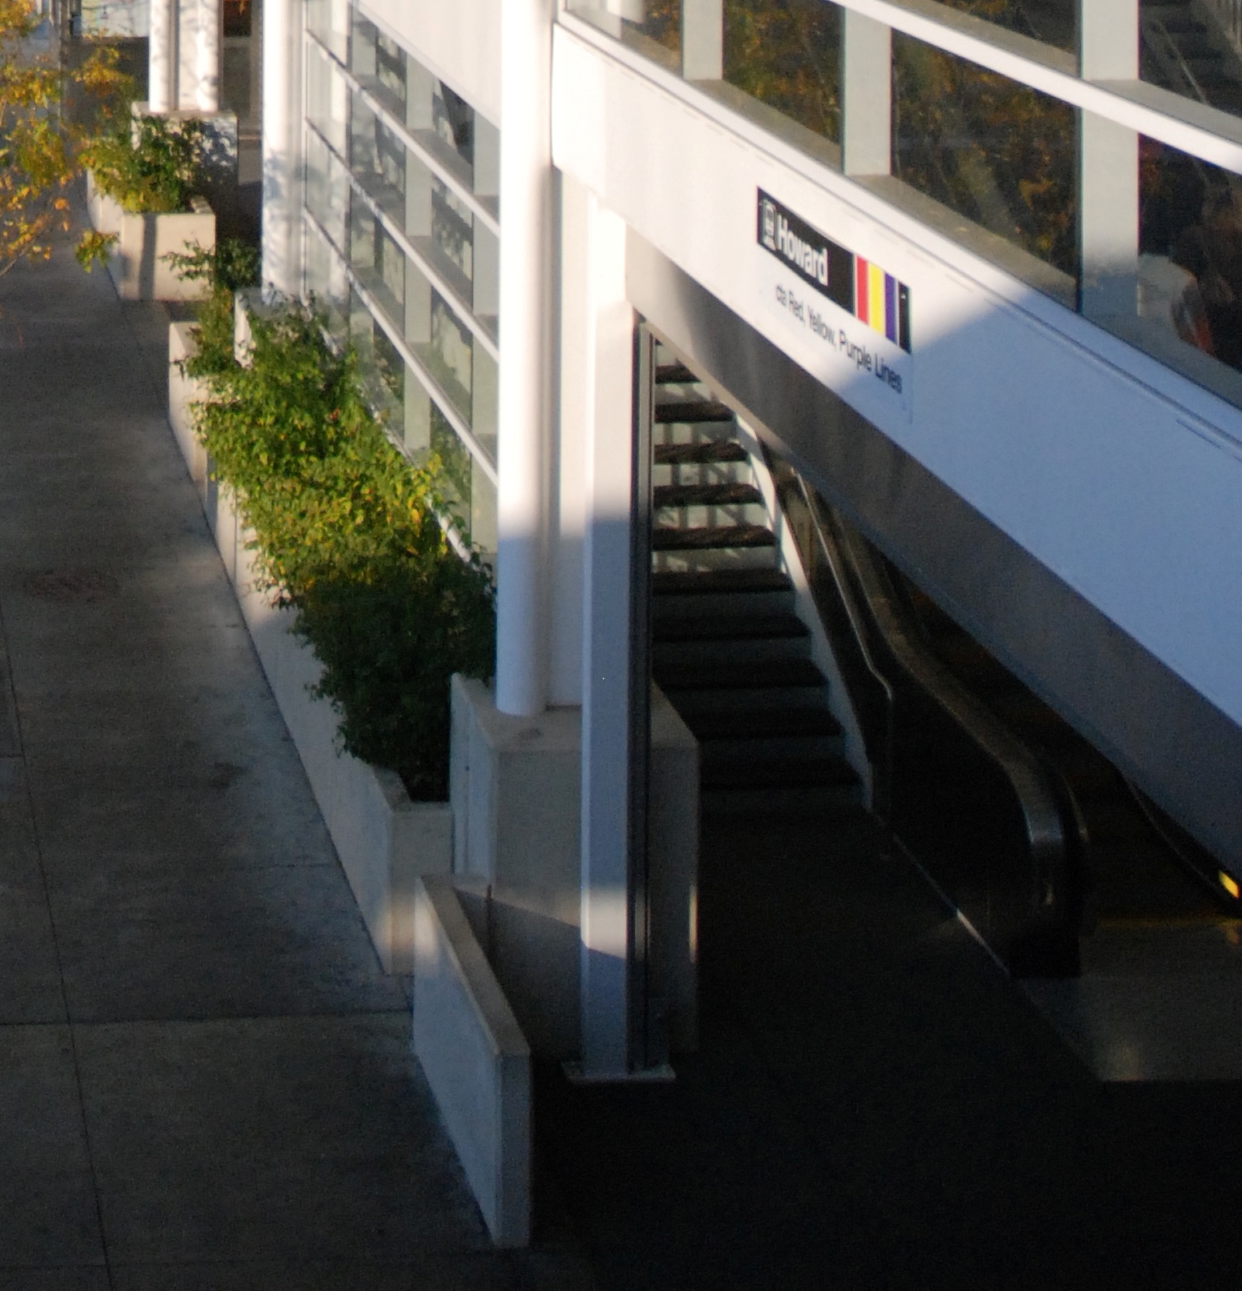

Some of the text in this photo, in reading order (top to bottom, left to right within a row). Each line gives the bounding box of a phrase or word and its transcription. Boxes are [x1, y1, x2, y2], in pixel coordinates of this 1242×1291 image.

[776, 213, 828, 287] Howard
[808, 306, 836, 351] Yellow,
[839, 329, 872, 372] Purple
[875, 353, 903, 394] Lines
